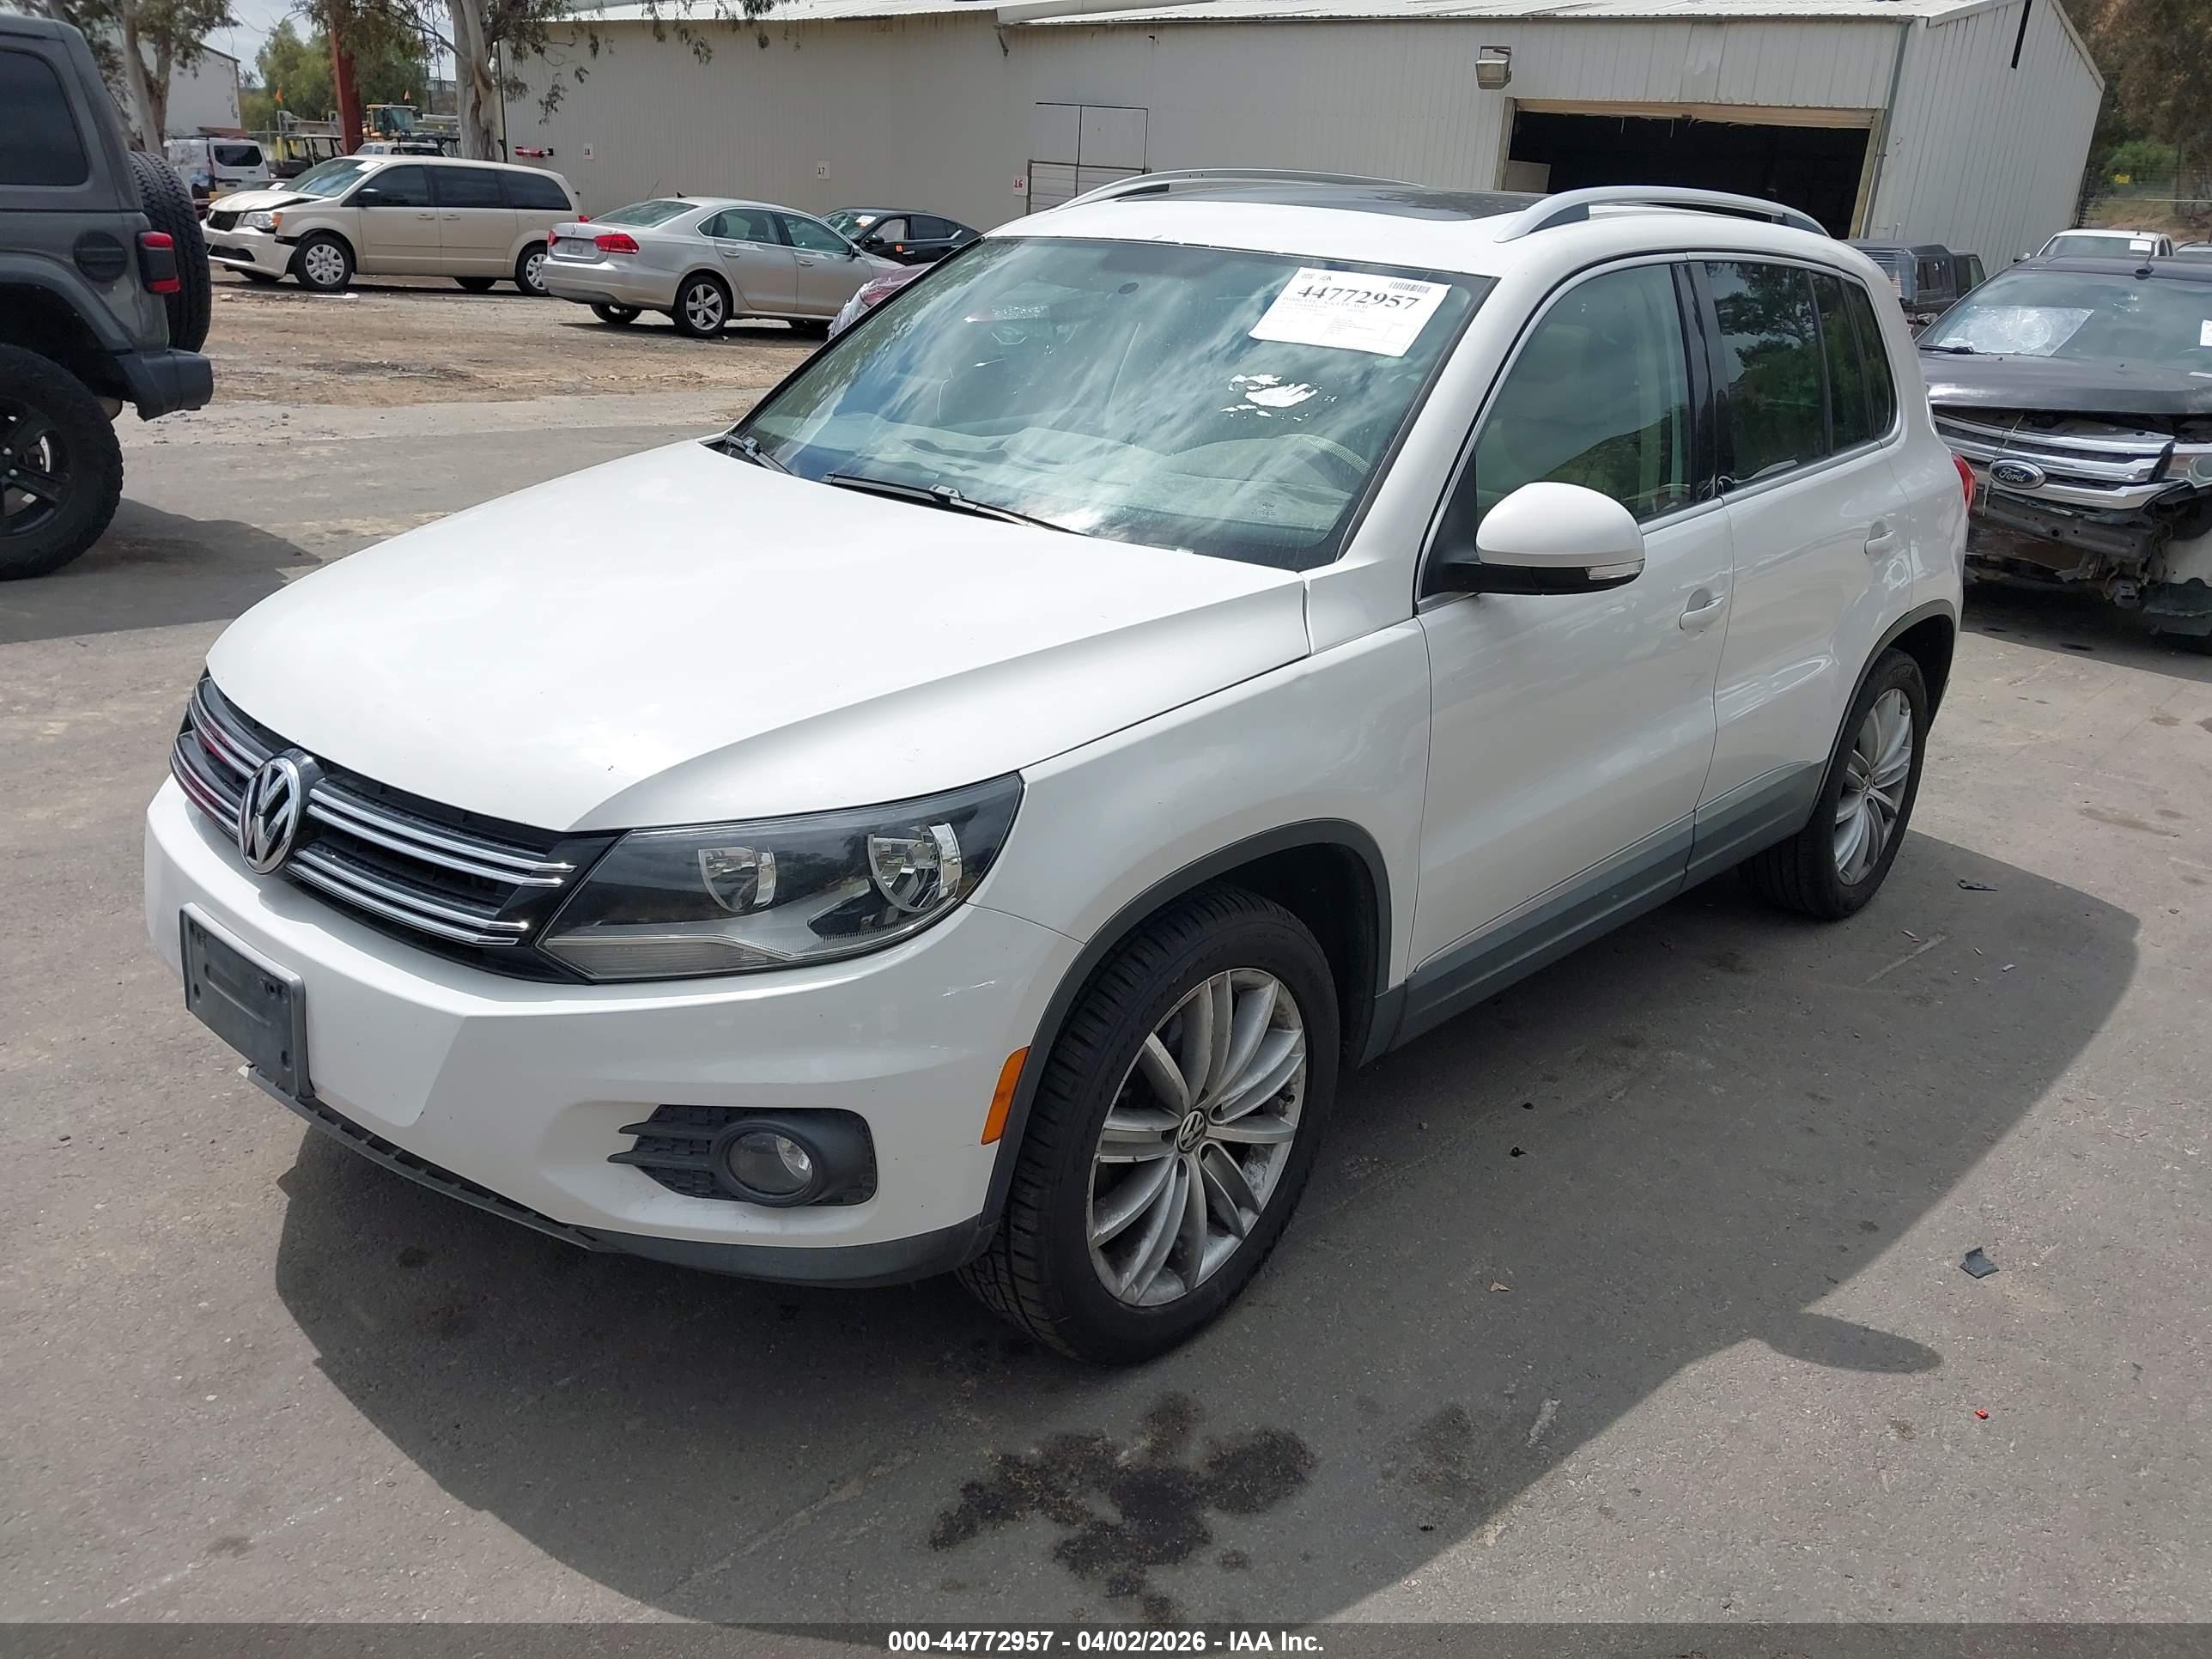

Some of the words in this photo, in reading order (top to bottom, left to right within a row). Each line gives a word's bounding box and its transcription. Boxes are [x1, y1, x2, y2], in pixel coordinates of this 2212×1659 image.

[817, 167, 825, 175] 17
[1014, 179, 1024, 189] 16
[1297, 284, 1422, 310] 44772957
[1998, 466, 2027, 483] Ford
